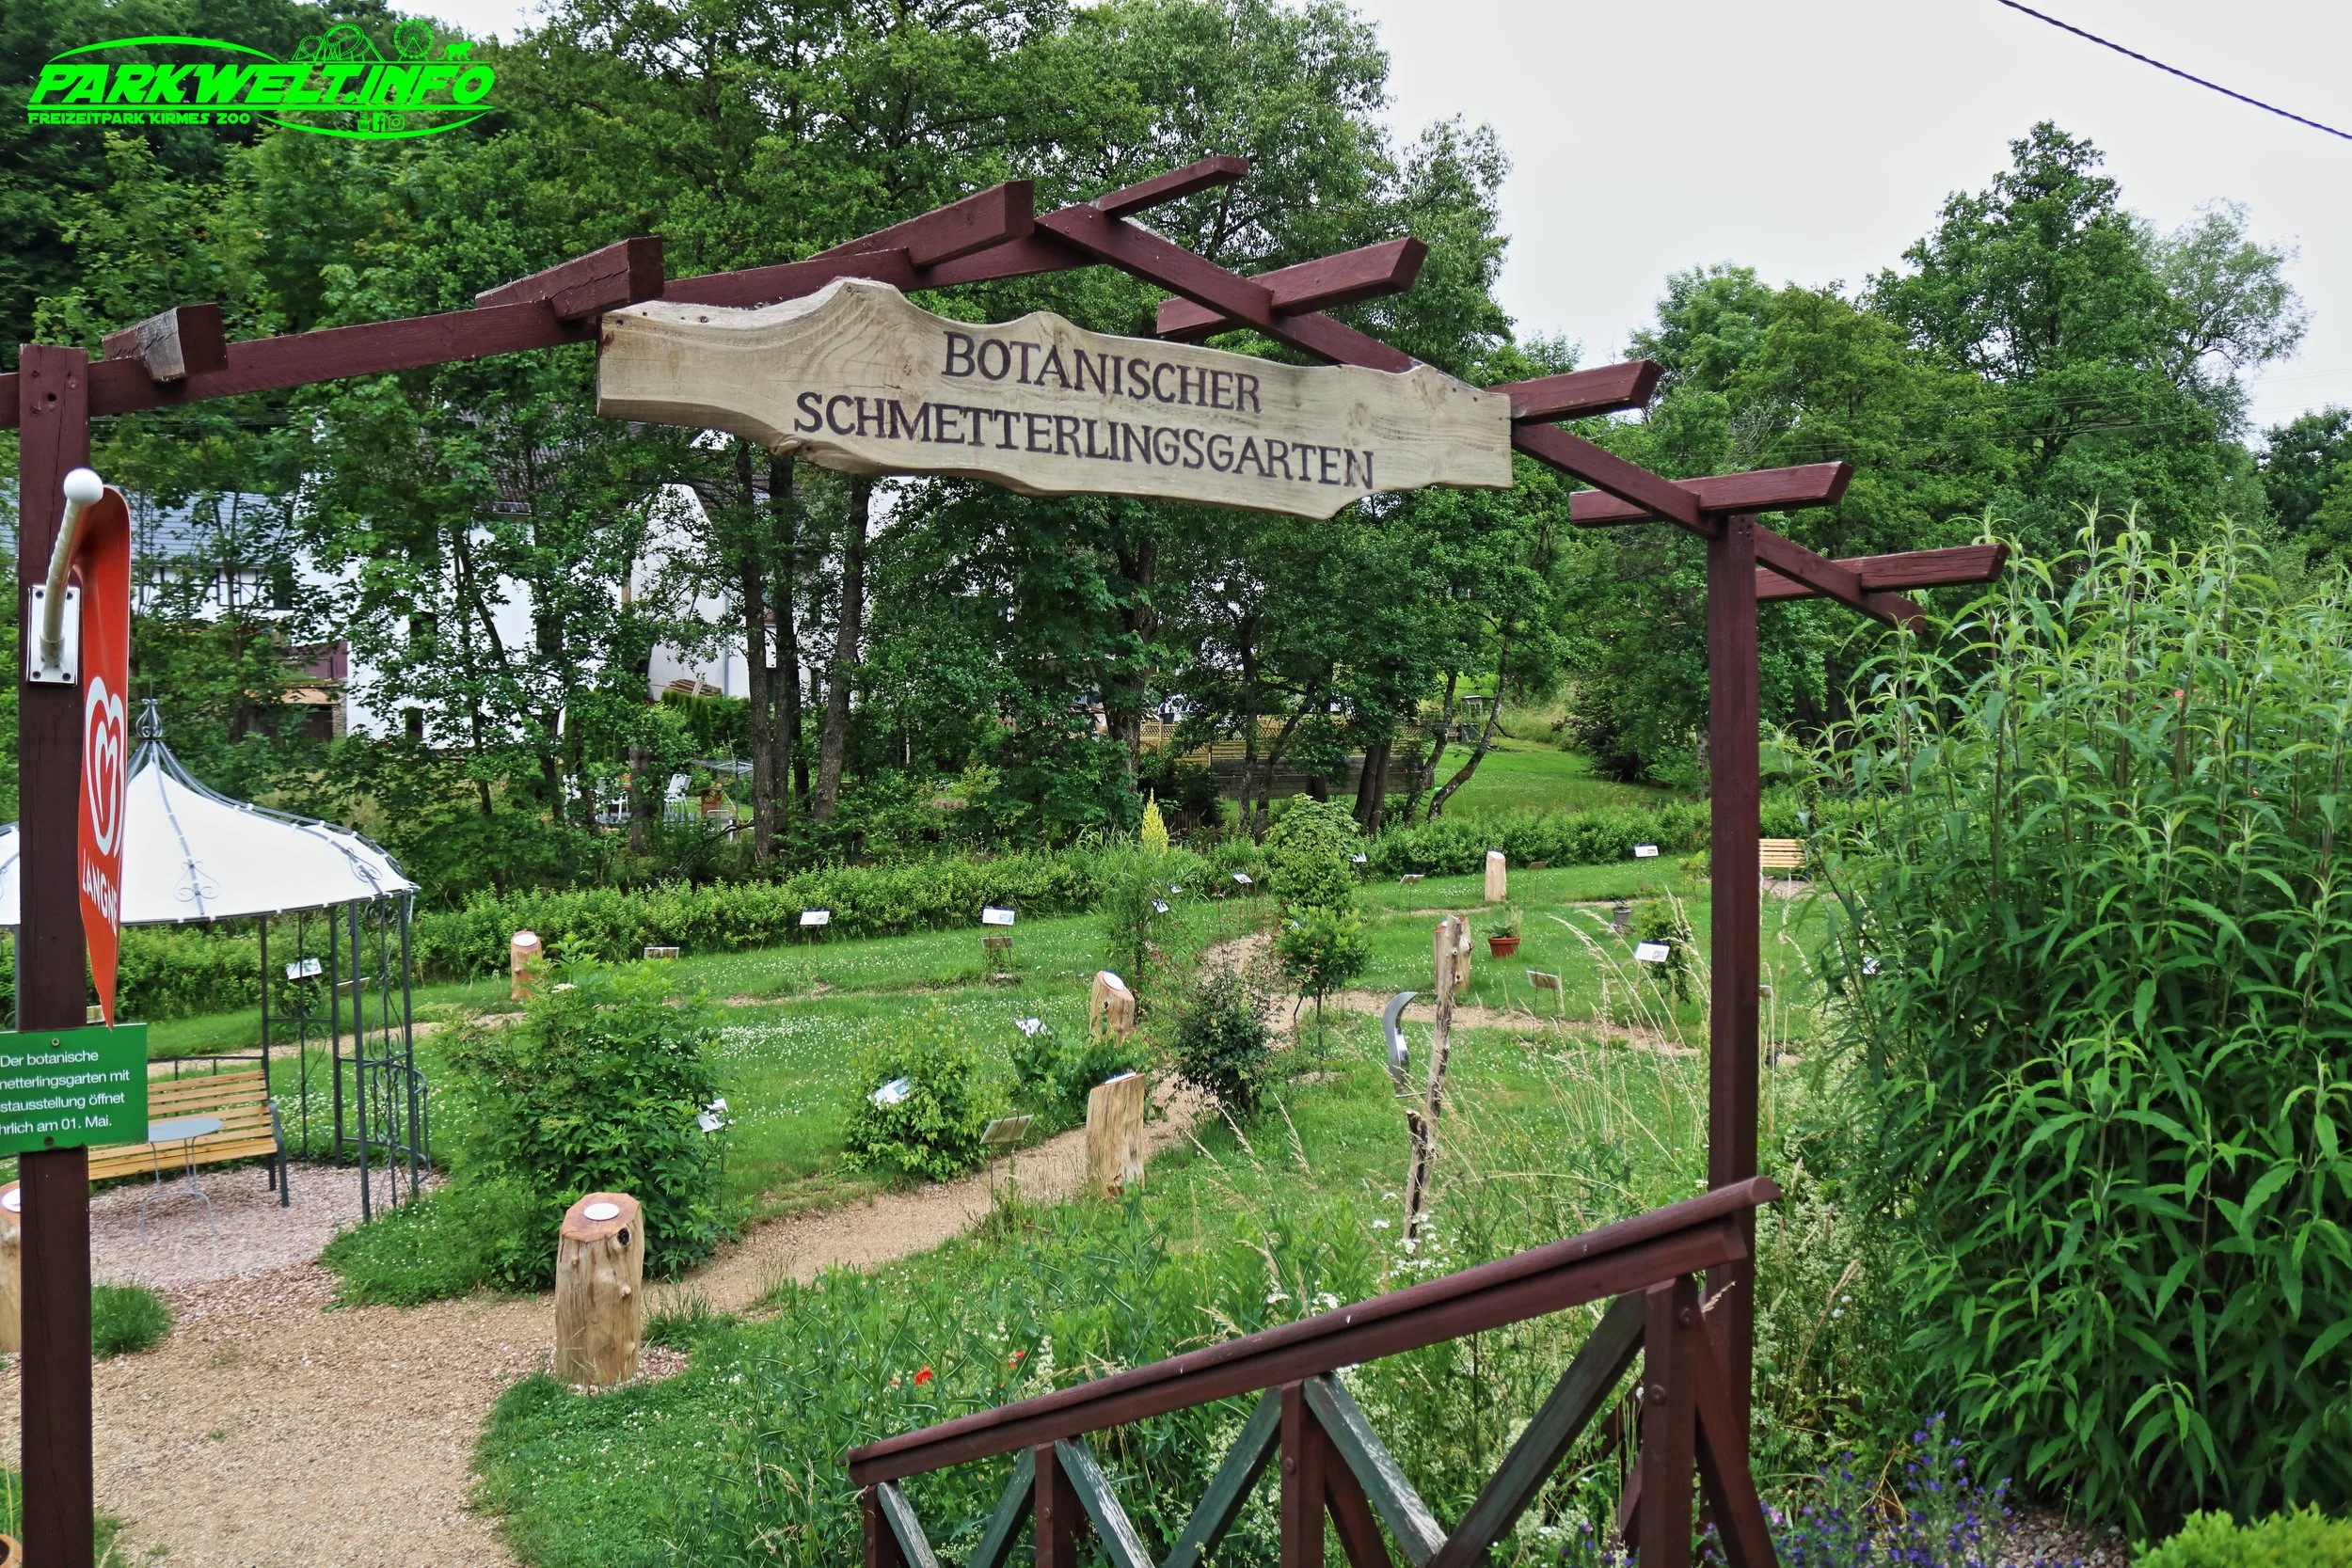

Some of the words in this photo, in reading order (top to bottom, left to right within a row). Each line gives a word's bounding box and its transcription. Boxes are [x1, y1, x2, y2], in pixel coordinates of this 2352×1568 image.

[941, 330, 1263, 414] BOTANISCHER
[794, 391, 1375, 490] SCHMETTERLINGSGARTEN
[0, 1054, 24, 1068] Der
[27, 1050, 99, 1065] botanische
[110, 1069, 130, 1083] mit
[0, 1096, 86, 1113] stausstellung
[88, 1092, 125, 1105] öffnet
[37, 1121, 58, 1133] am
[61, 1117, 81, 1131] 01.
[85, 1115, 112, 1129] Mai.
